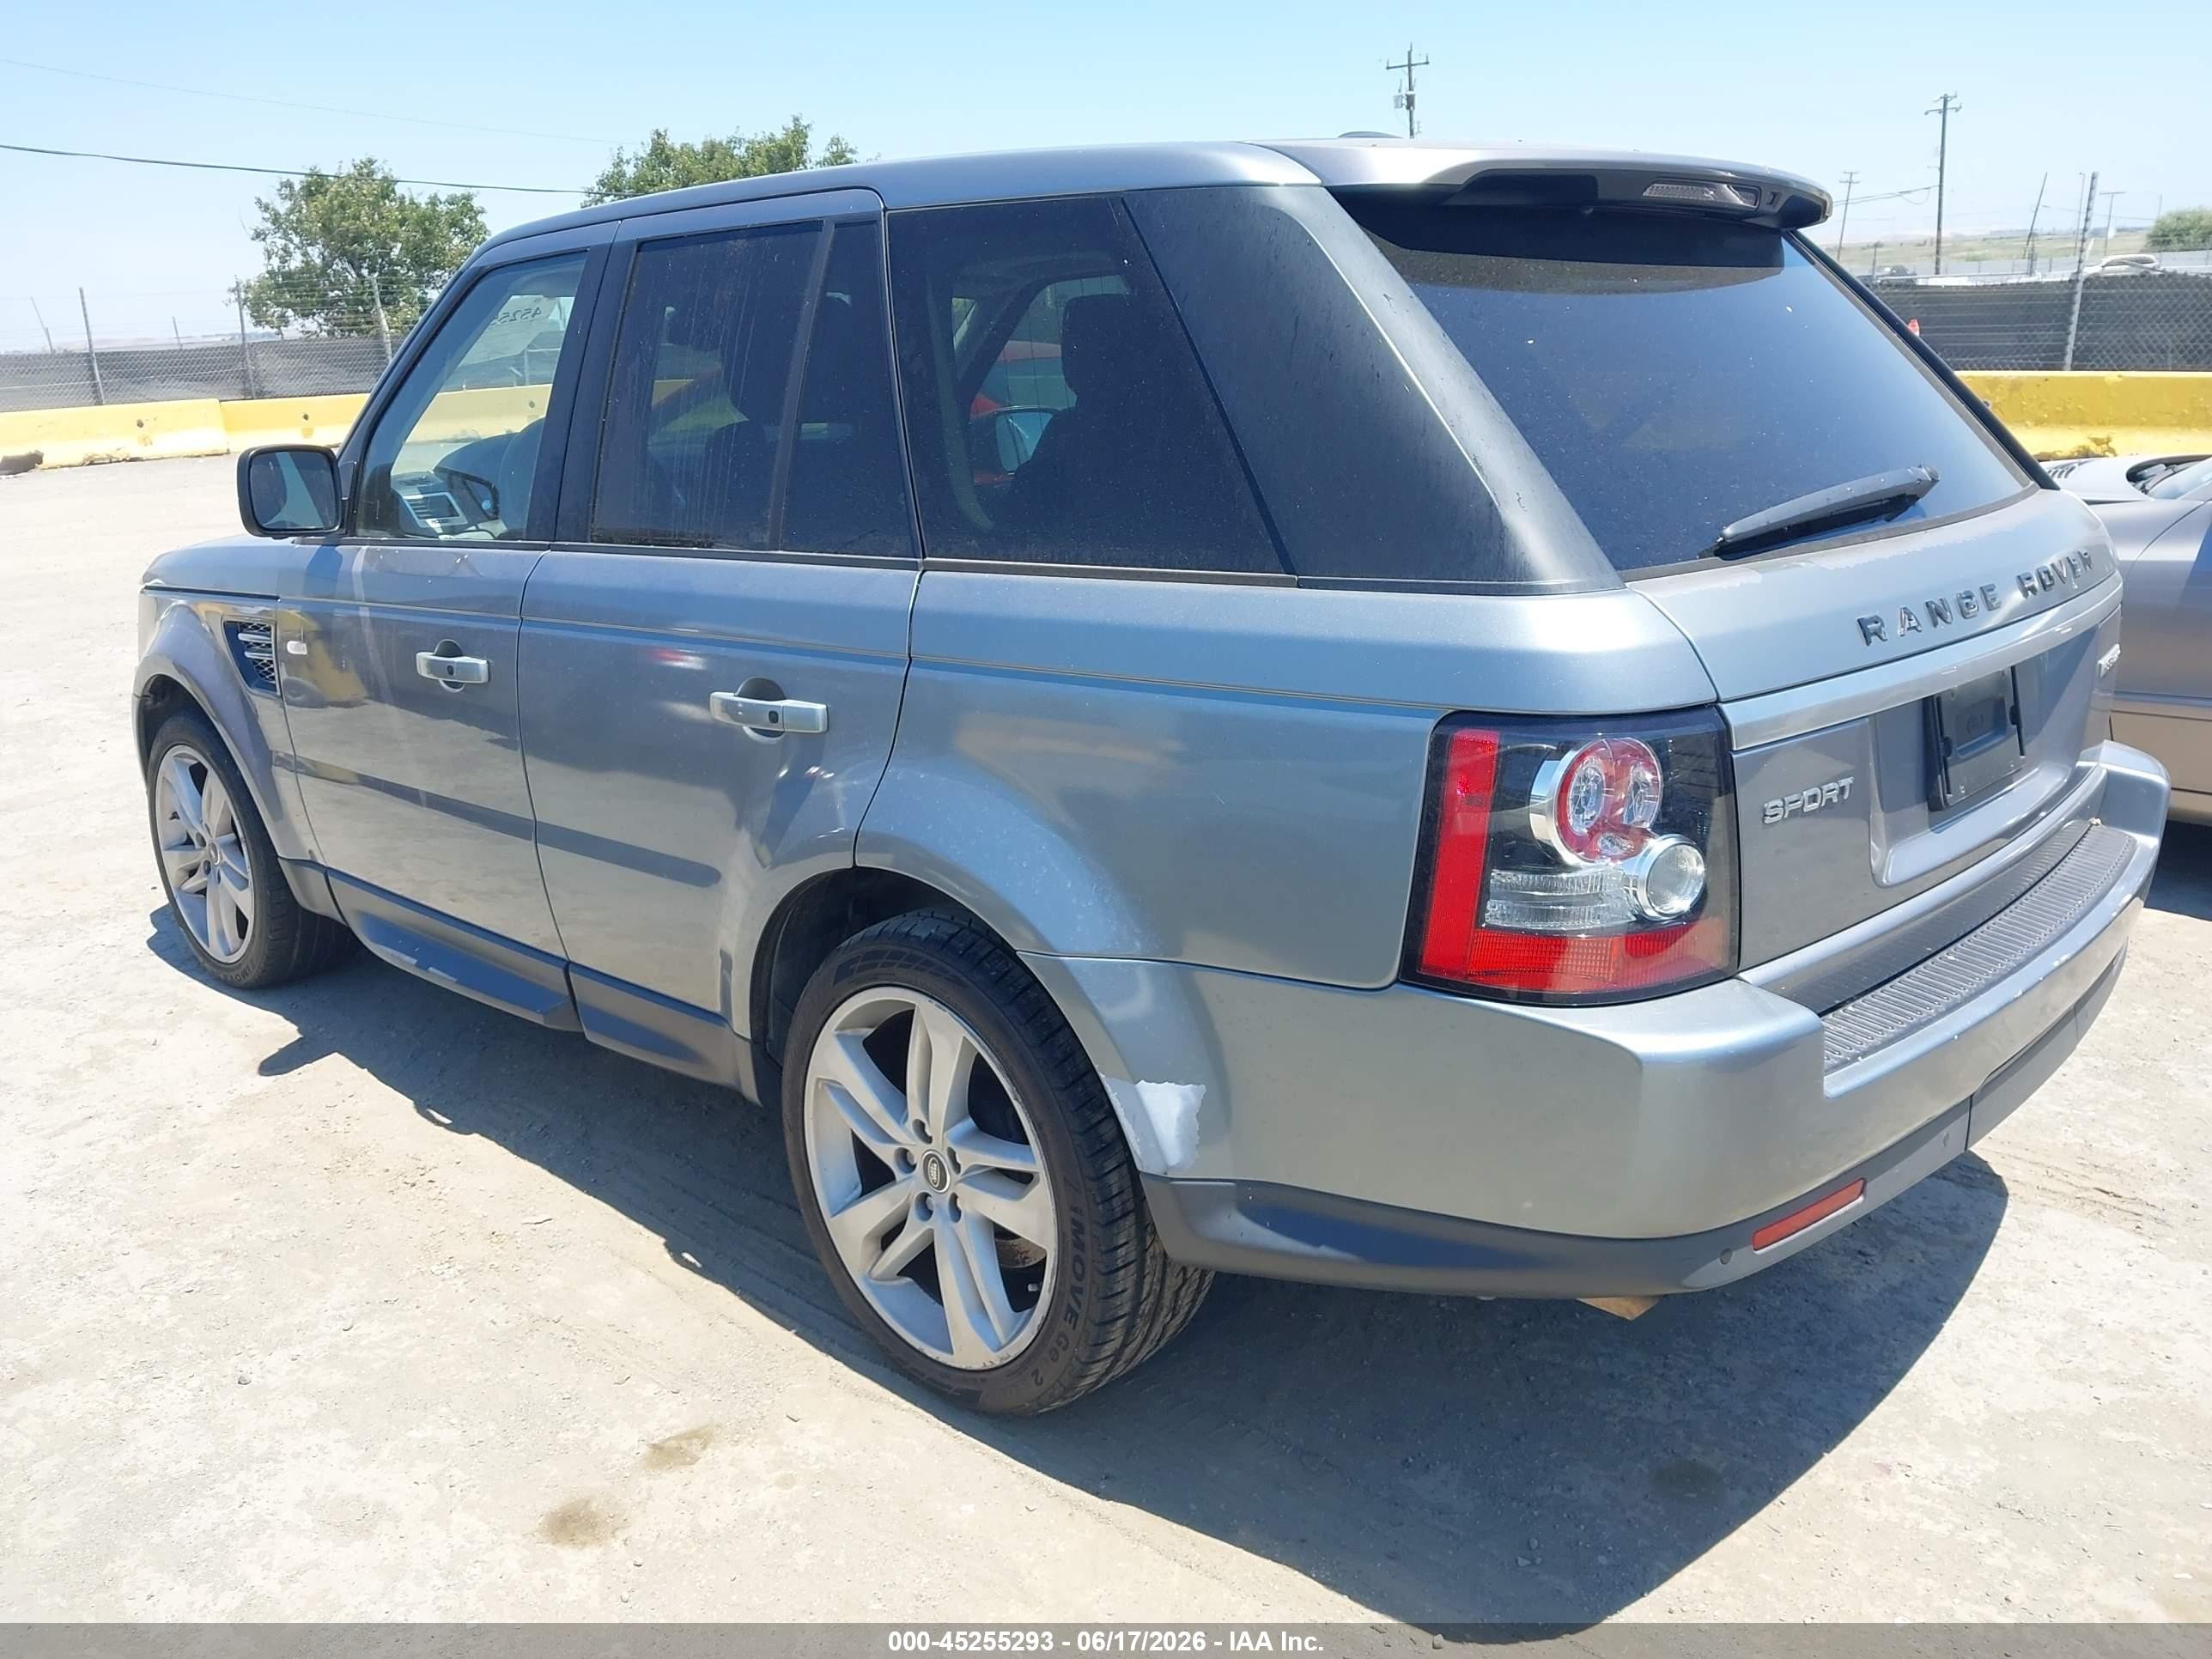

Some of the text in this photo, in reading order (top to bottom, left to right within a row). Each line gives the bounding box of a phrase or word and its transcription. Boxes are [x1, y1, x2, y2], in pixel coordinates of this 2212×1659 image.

[1856, 549, 2094, 646] RANGE ROVER
[1763, 775, 1855, 824] SPORT
